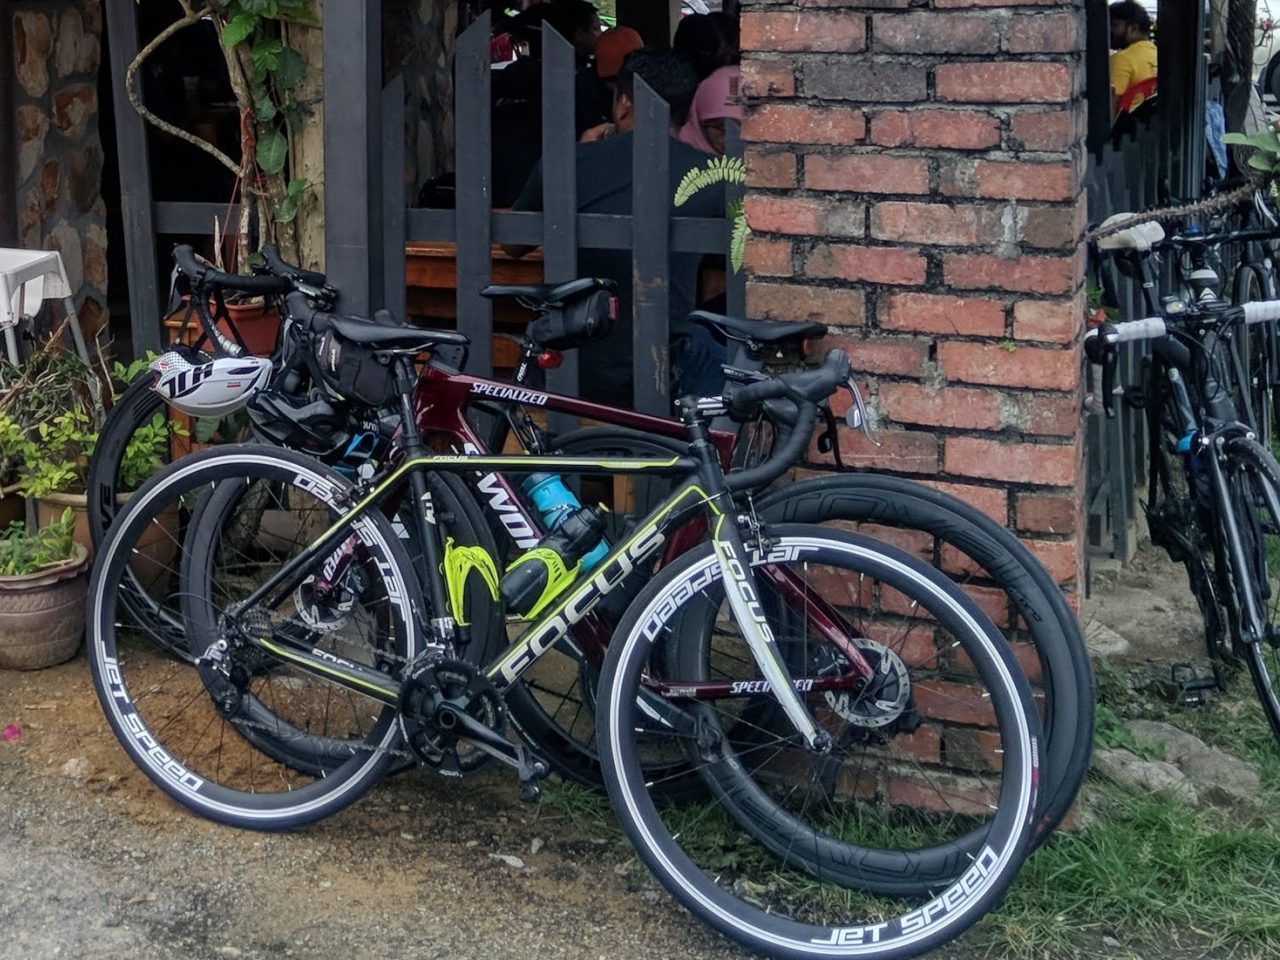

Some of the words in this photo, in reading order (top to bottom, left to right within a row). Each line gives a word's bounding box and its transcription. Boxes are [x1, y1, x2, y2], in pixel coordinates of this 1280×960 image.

[470, 382, 549, 406] SPECIALIZED
[501, 524, 666, 684] FOCUS
[719, 540, 776, 643] FOCUS
